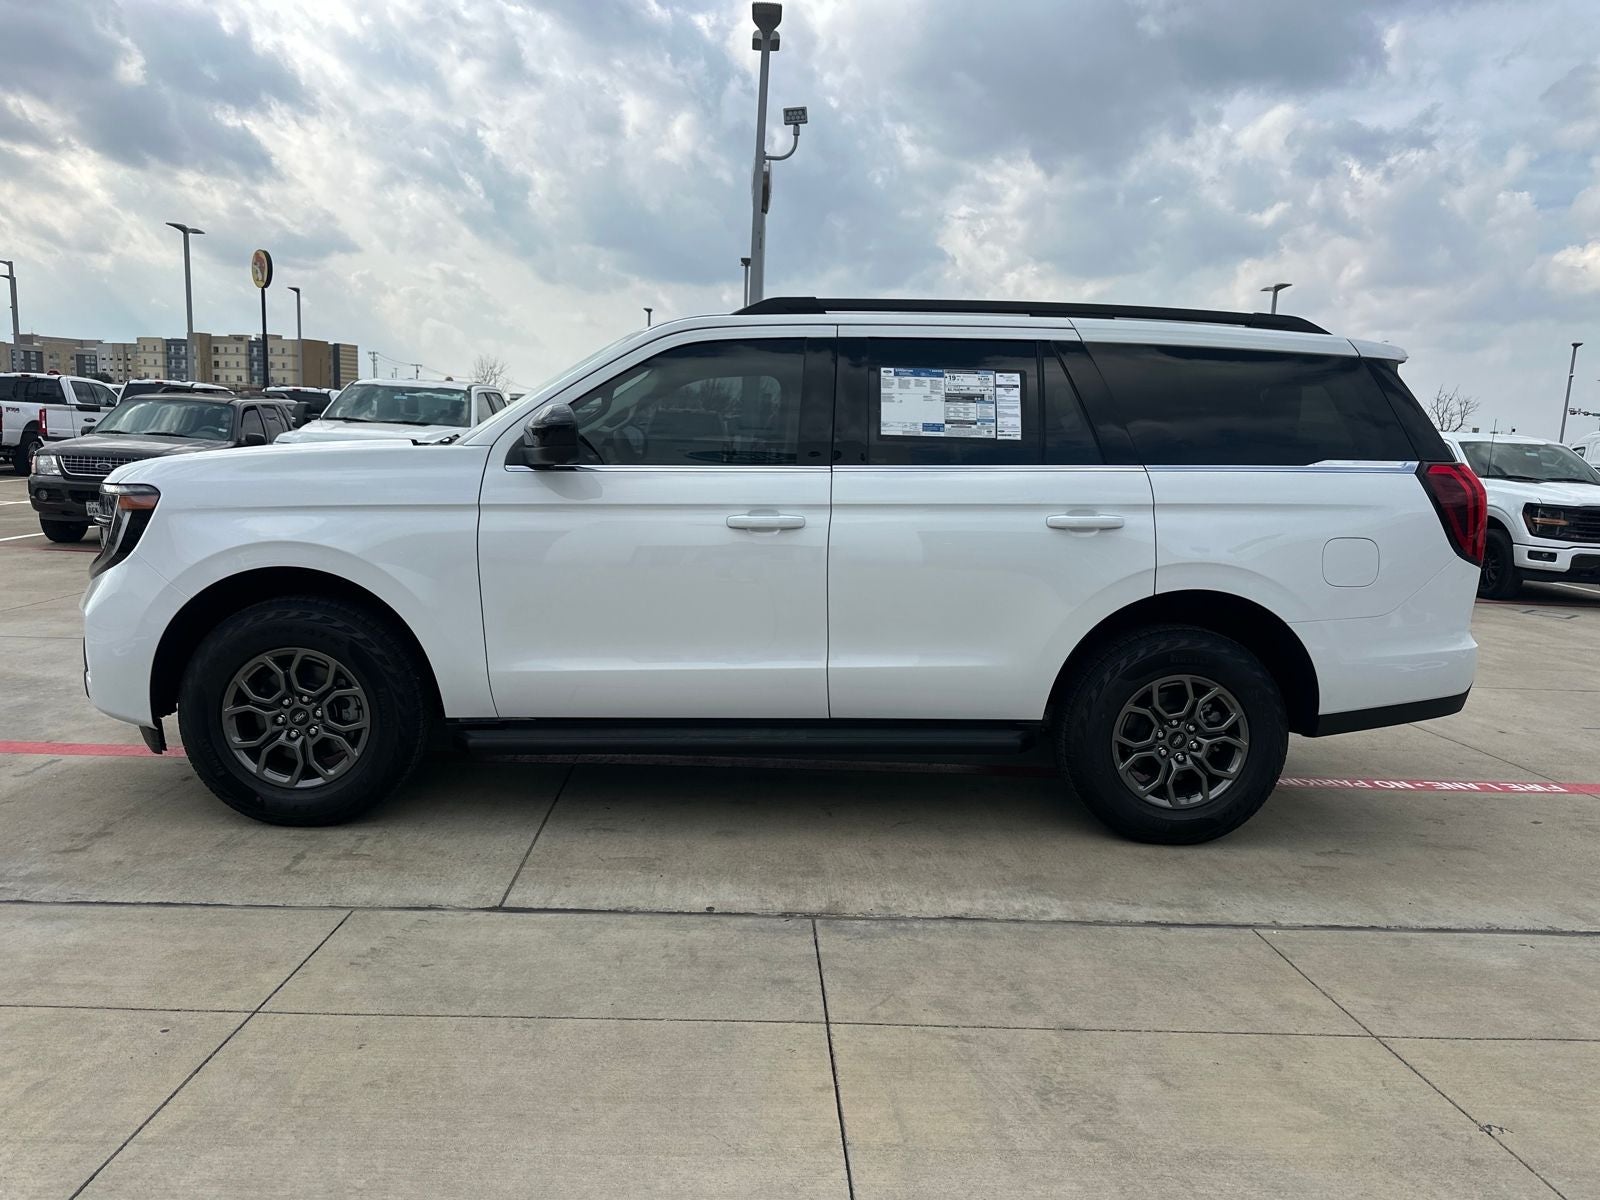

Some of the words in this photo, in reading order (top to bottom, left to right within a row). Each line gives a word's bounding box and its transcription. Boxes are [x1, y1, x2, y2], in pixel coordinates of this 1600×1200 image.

[1276, 778, 1372, 788] PARKIN
[1374, 780, 1415, 789] NO
[1499, 783, 1568, 792] FIRE
